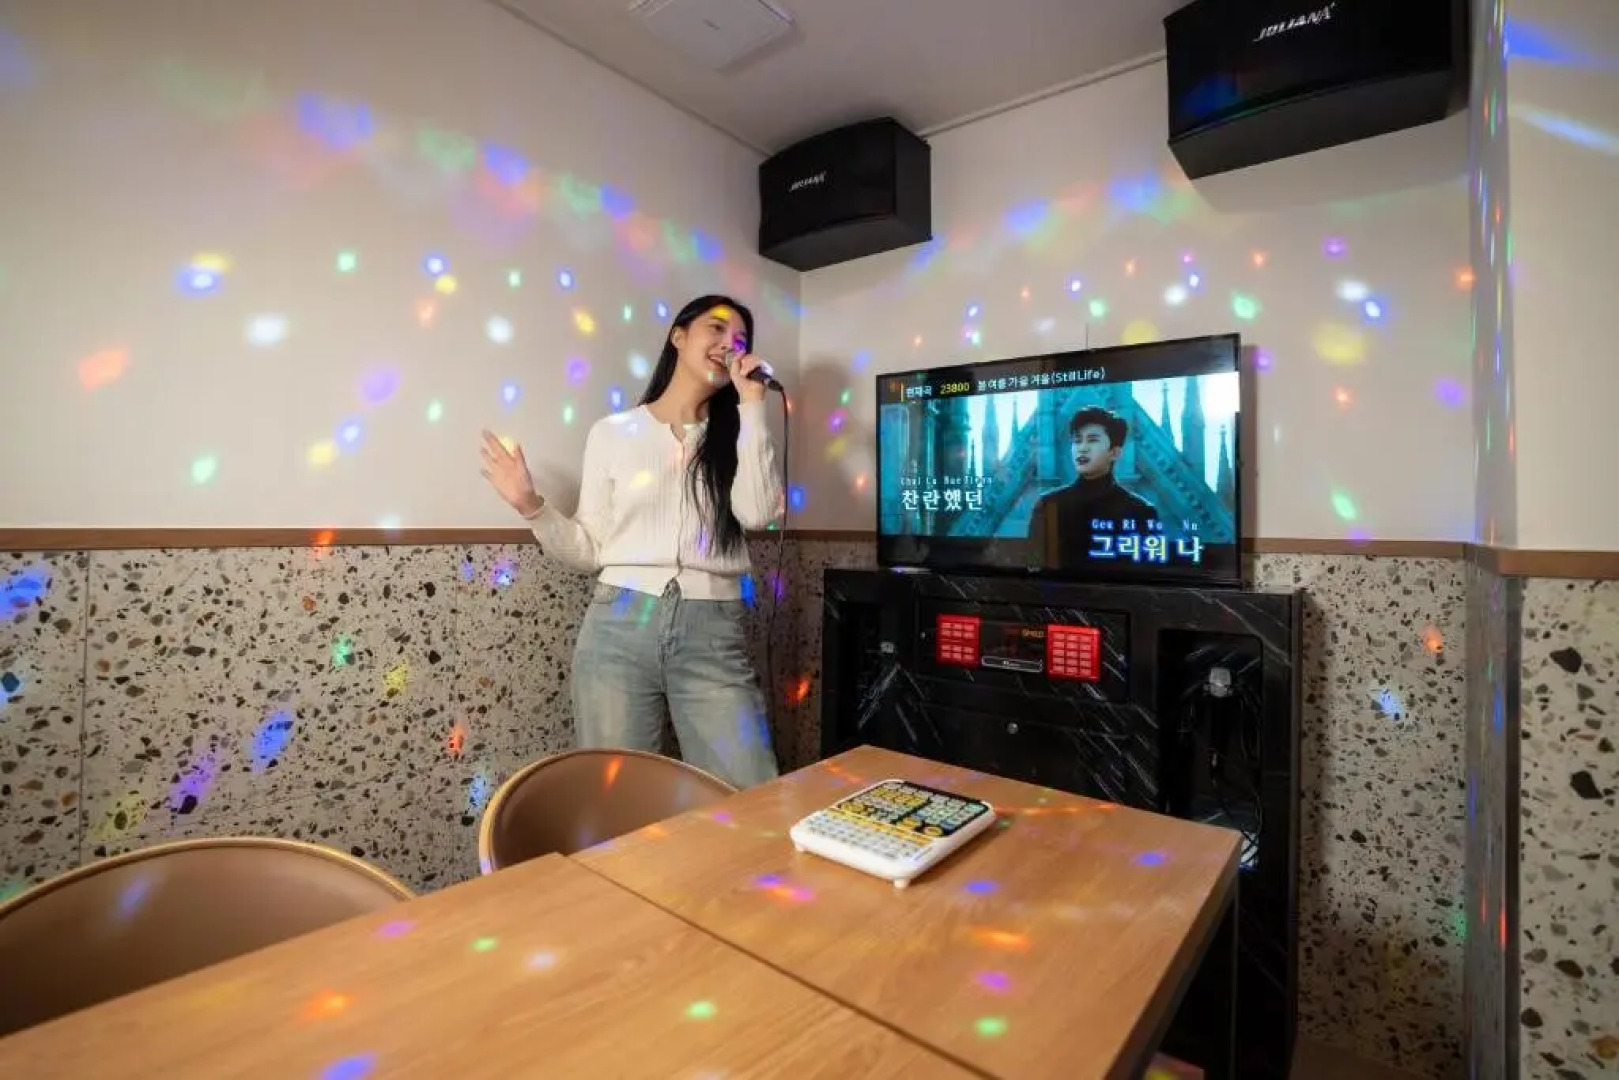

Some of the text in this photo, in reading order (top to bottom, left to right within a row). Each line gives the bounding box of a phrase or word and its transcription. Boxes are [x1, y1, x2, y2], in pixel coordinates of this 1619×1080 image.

[902, 489, 983, 511] 찬란했던
[1088, 534, 1205, 563] 그리워 나
